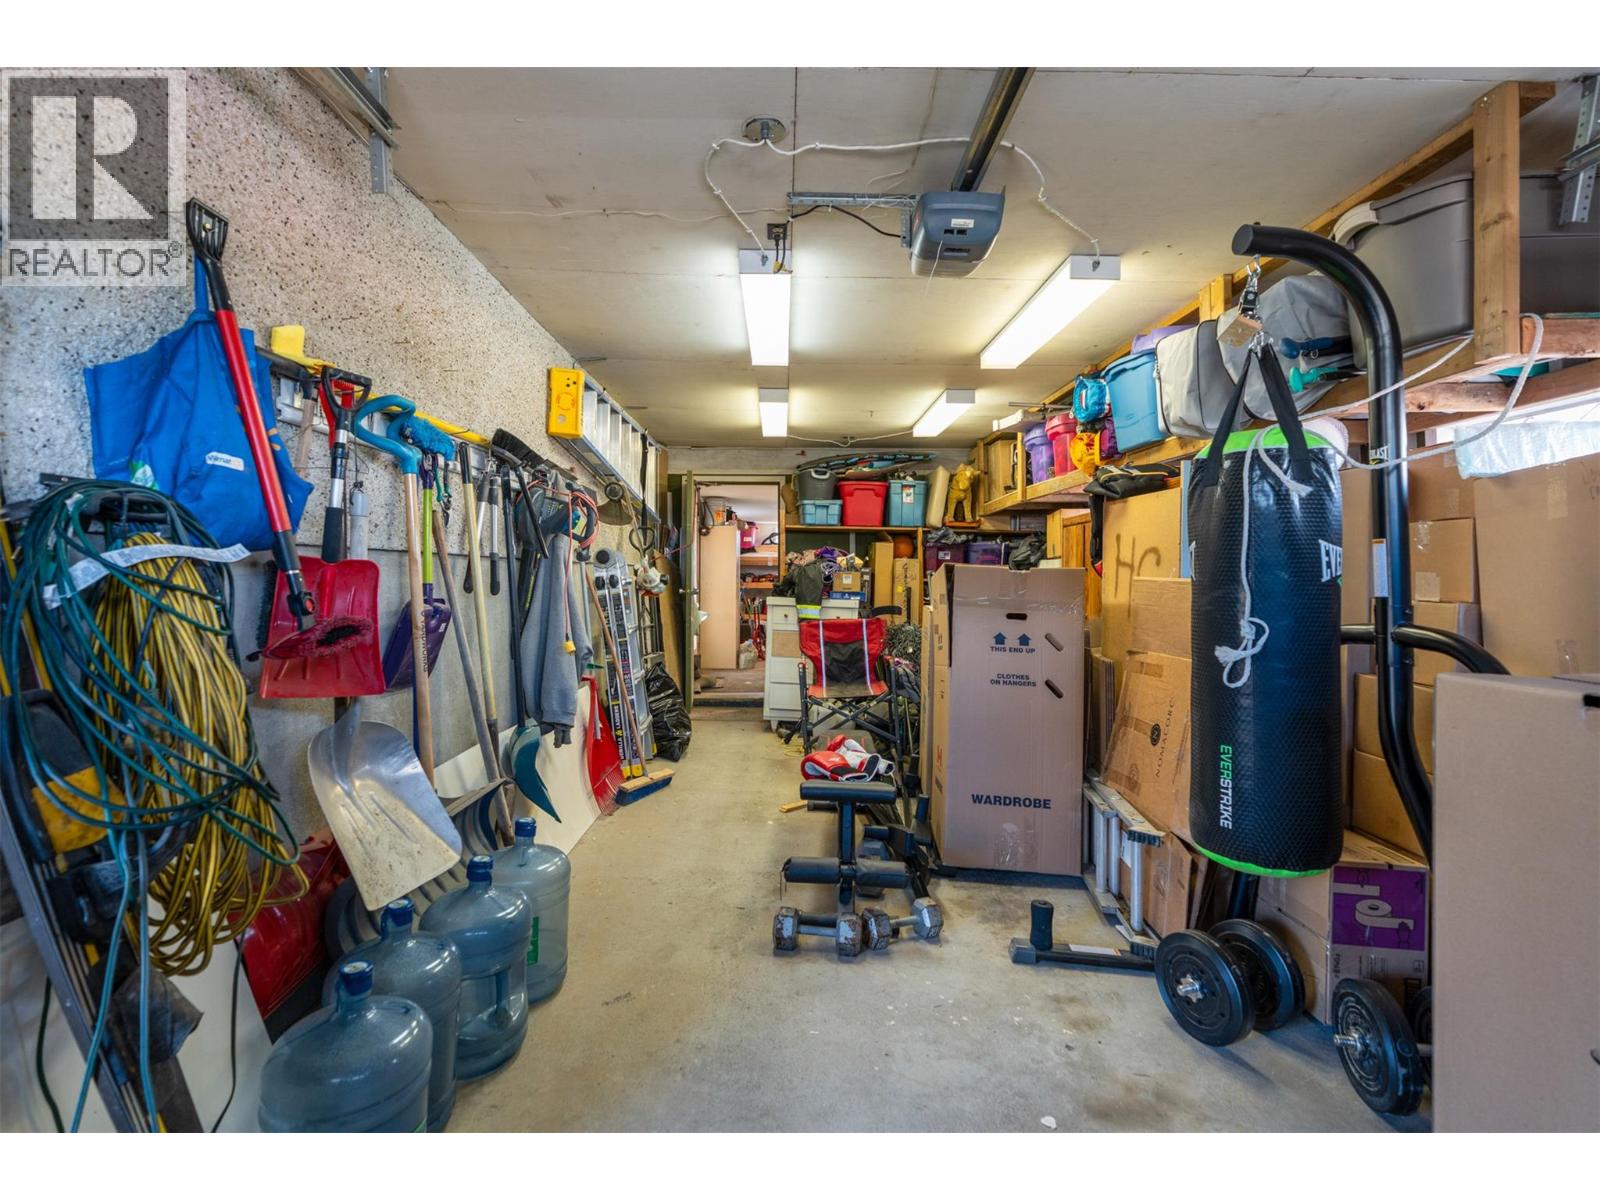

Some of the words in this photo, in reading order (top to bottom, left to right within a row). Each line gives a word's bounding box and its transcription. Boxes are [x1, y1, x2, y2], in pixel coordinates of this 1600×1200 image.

[996, 673, 1030, 681] CLOTHES
[1002, 679, 1037, 687] HANGERS
[1219, 744, 1233, 830] EVERSTRIKE
[971, 793, 1052, 810] WARDROBE
